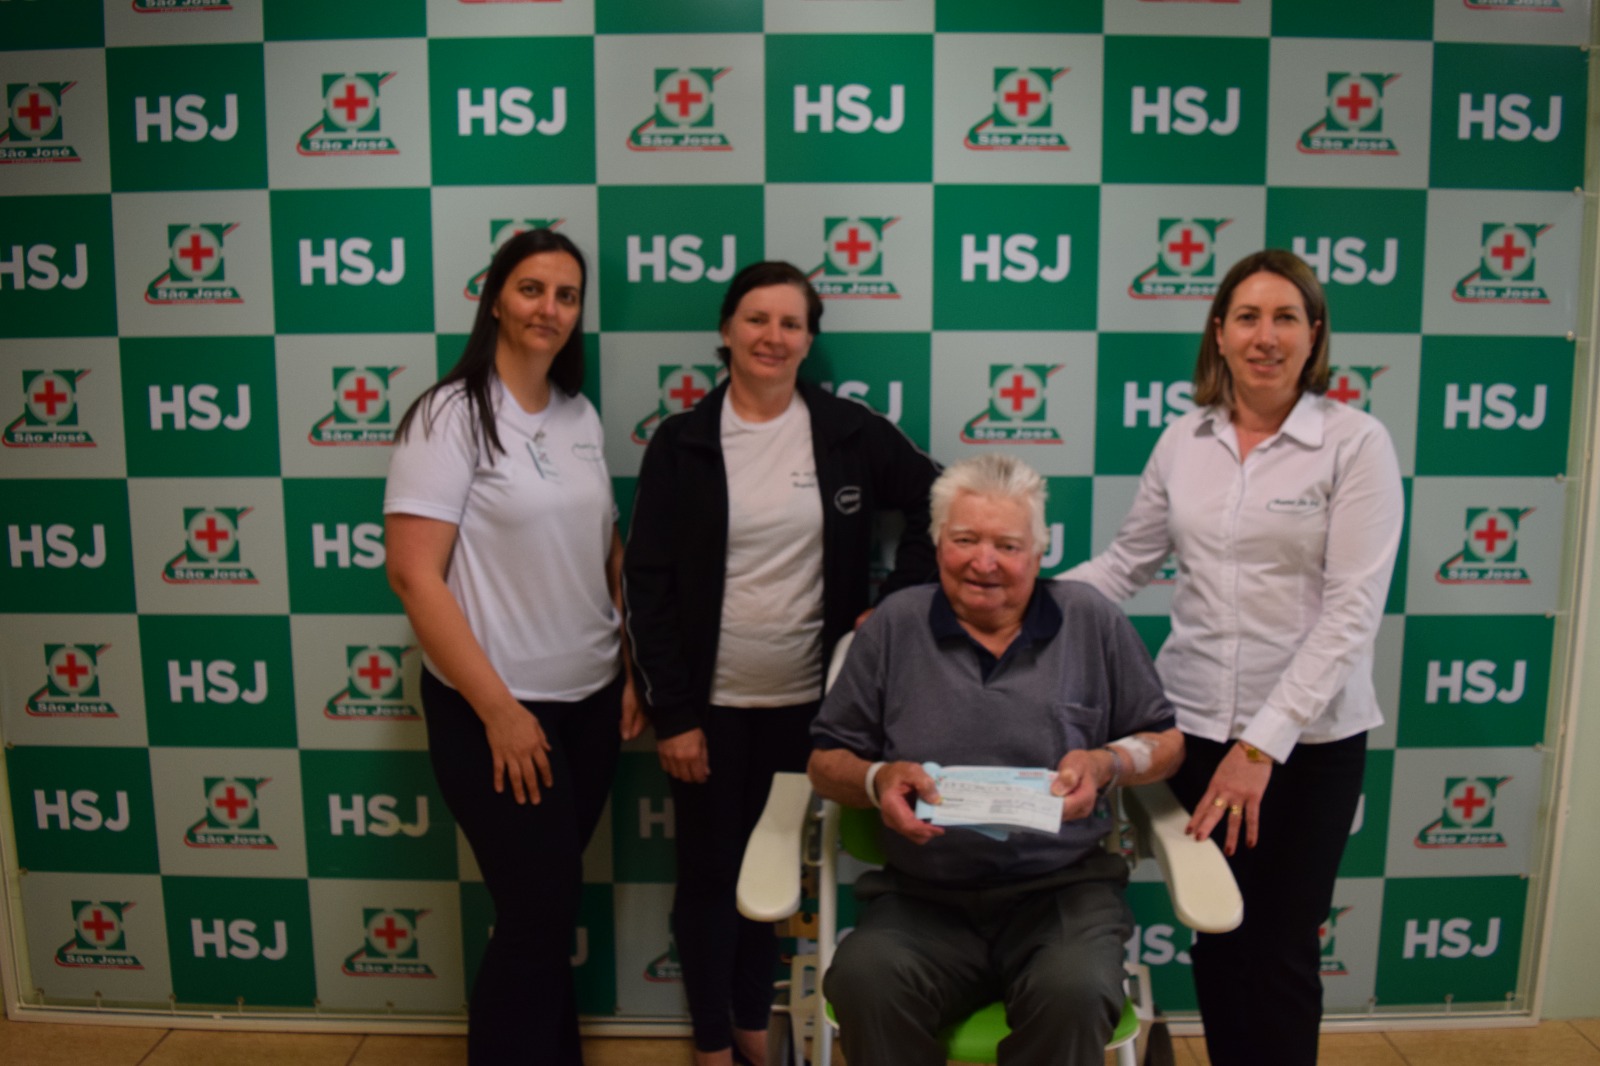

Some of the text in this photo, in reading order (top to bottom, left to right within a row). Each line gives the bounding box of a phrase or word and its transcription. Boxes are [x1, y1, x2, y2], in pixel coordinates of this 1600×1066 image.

[135, 93, 238, 142] HSJ
[458, 86, 566, 136] HSJ
[794, 84, 904, 133] HSJ
[1132, 86, 1240, 136] HSJ
[1458, 93, 1562, 142] HSJ
[0, 243, 89, 290] HSJ
[299, 238, 406, 286] HSJ
[627, 234, 736, 283] HSJ
[961, 234, 1071, 283] HSJ
[1292, 237, 1398, 285] HSJ
[149, 384, 251, 431] HSJ
[1123, 380, 1197, 428] HS
[1444, 383, 1547, 431] HSJ
[8, 523, 106, 569] HSJ
[312, 523, 386, 569] HS
[168, 660, 268, 704] HSJ
[1426, 660, 1526, 704] HSJ
[34, 789, 131, 832] HSJ
[328, 794, 430, 837] HSJ
[190, 918, 288, 960] HSJ
[1403, 918, 1501, 960] HSJ
